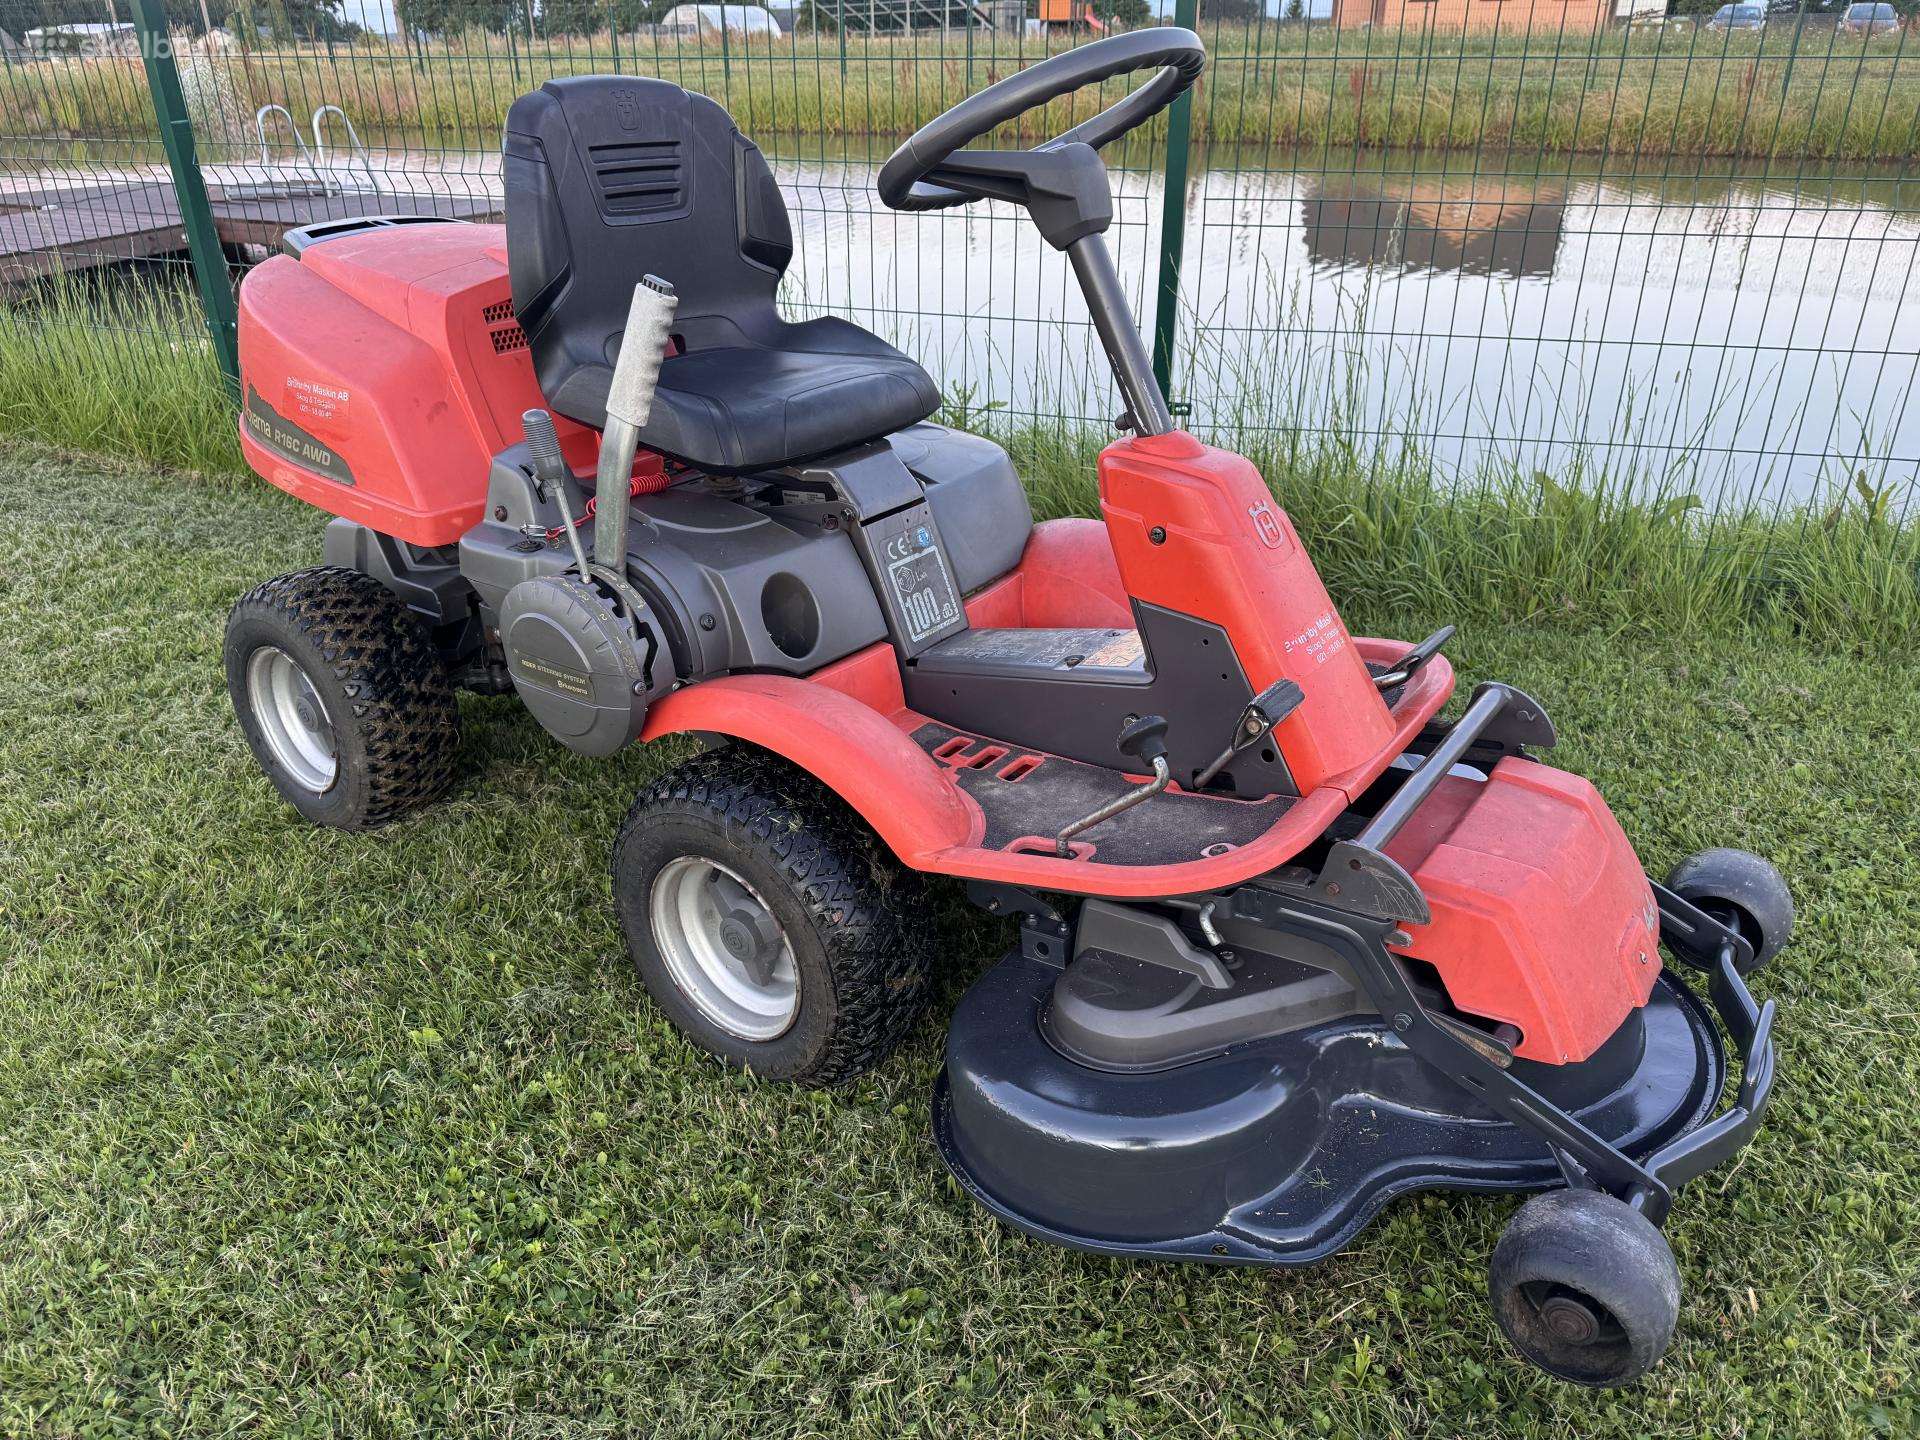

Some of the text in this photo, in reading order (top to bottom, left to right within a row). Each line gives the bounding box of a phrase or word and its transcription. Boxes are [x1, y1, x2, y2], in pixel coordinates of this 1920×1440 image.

[337, 390, 350, 401] AB
[274, 429, 300, 452] R16C
[302, 443, 331, 466] AWD
[905, 587, 941, 633] 100
